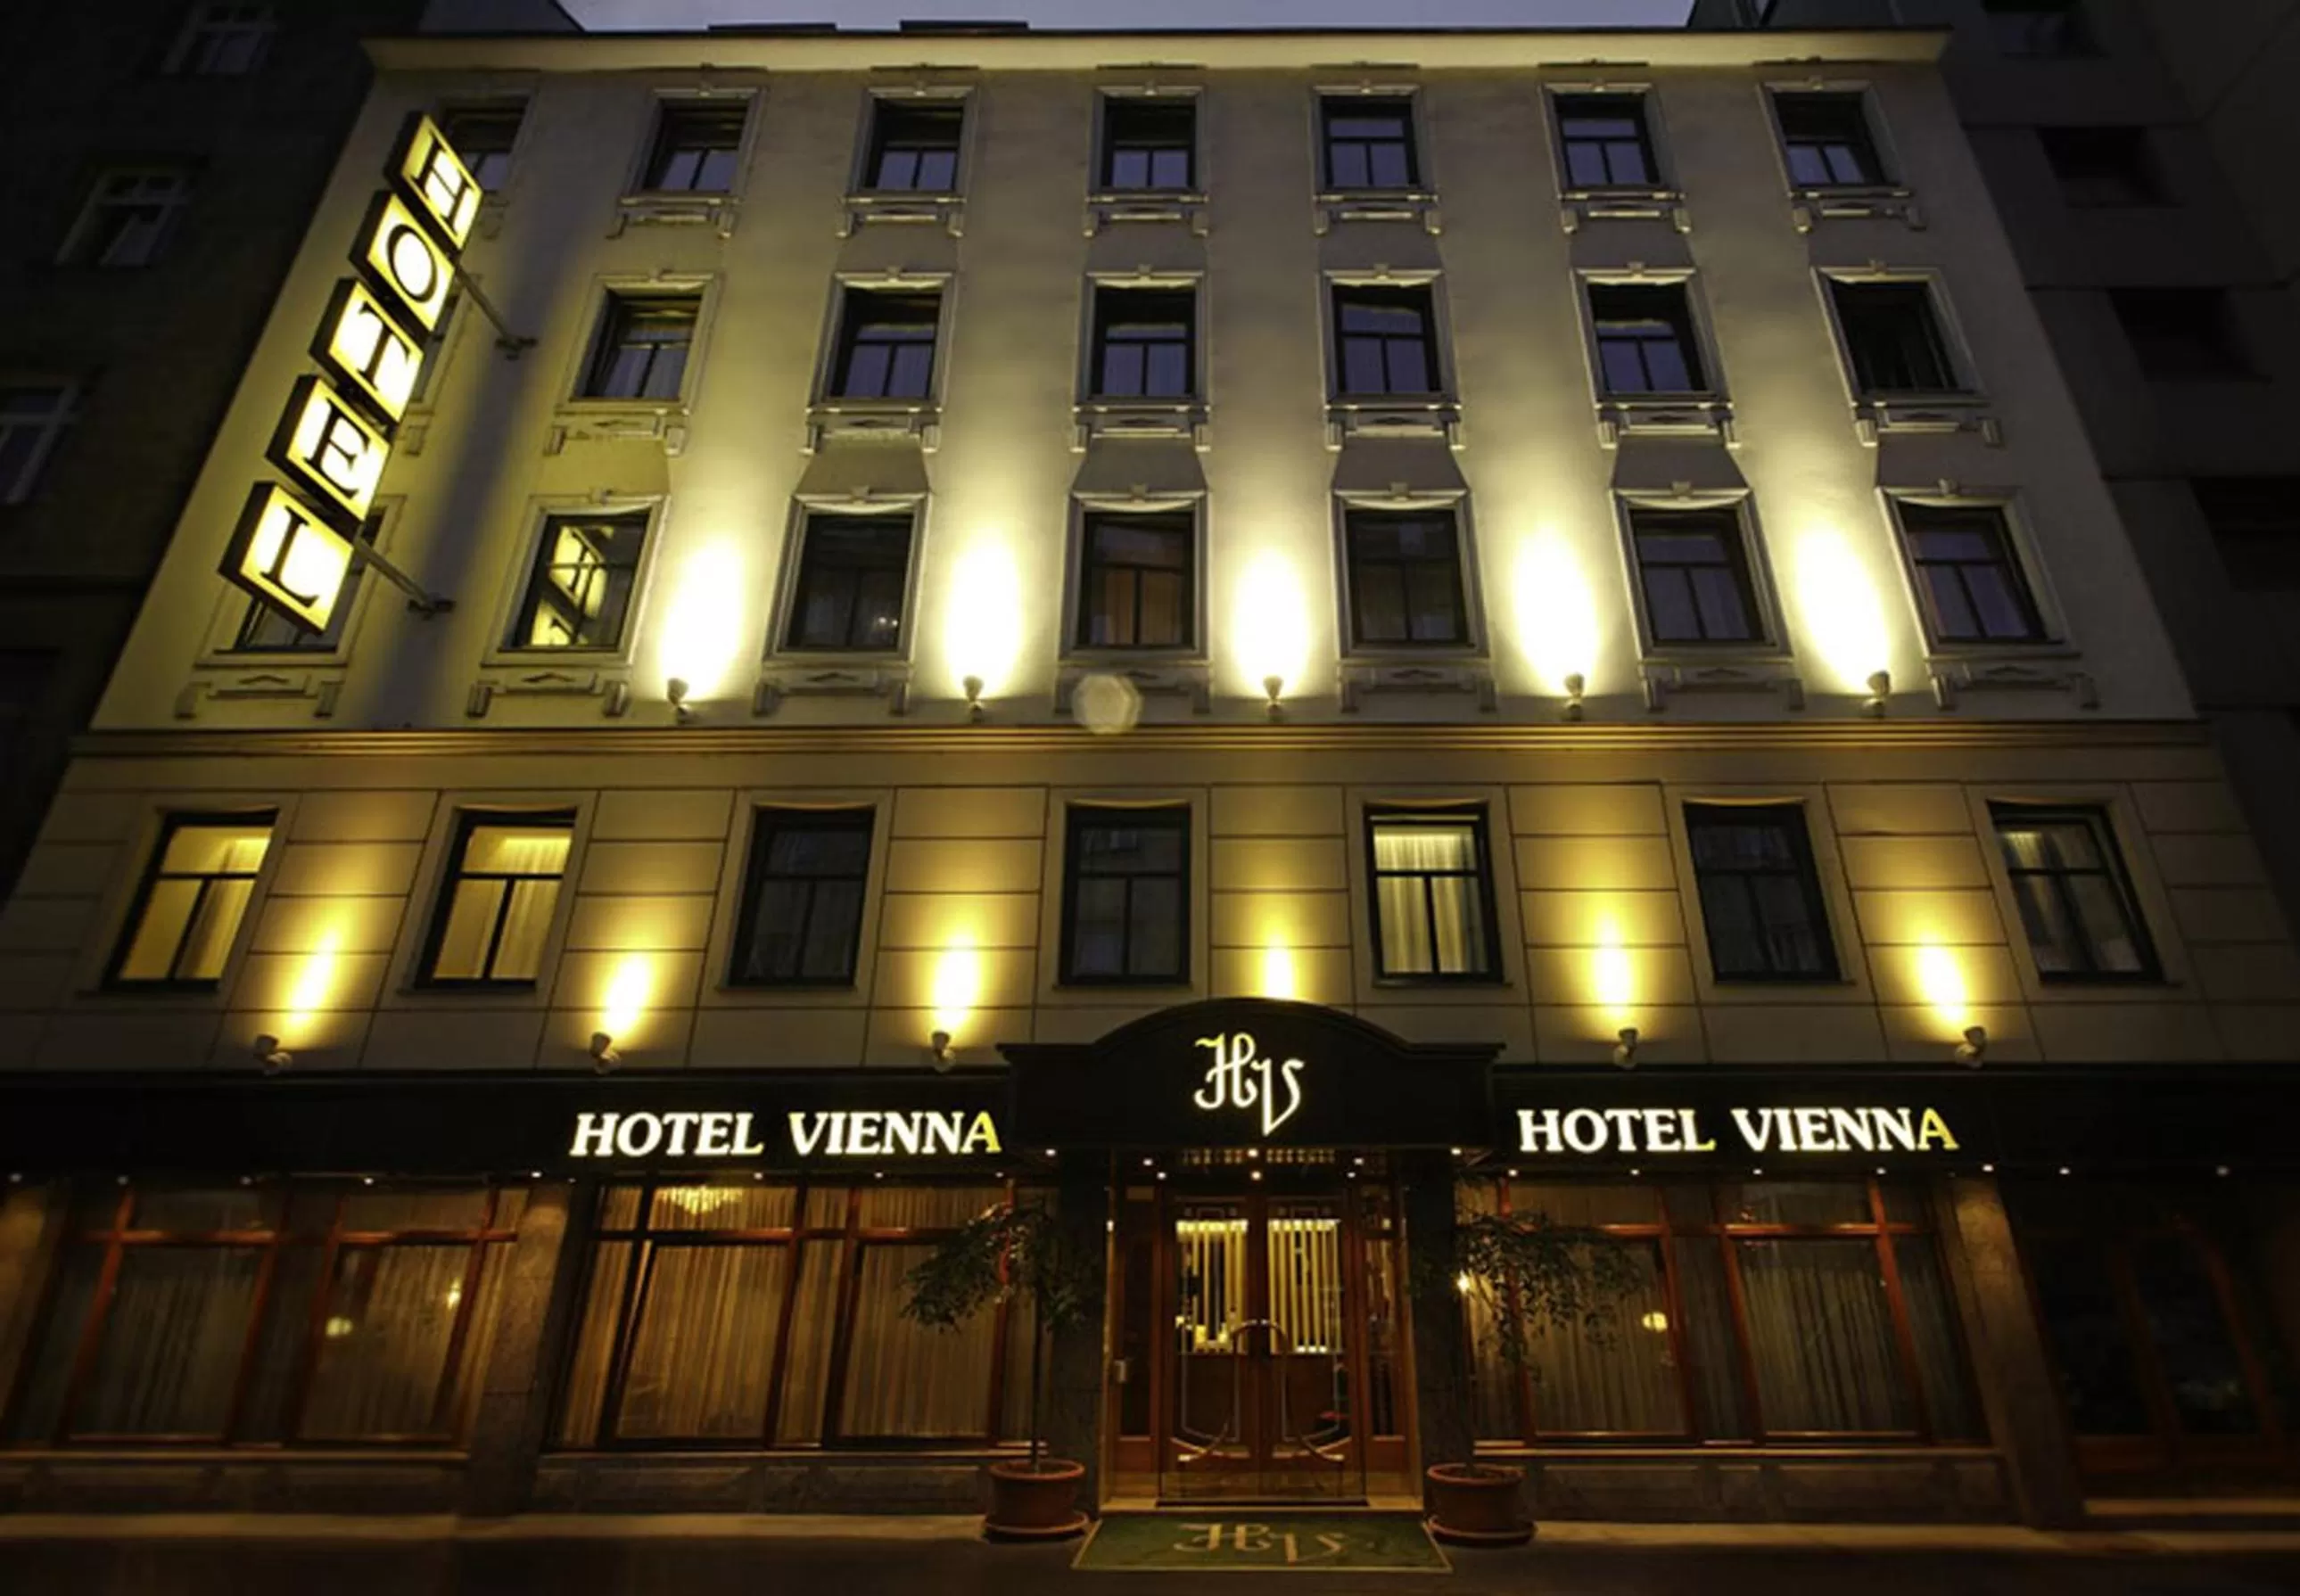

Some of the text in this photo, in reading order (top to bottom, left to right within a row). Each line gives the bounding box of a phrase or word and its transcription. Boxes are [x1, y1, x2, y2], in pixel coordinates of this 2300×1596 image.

[259, 129, 479, 608] HOTEL
[569, 1111, 1002, 1156] HOTEL VIENNA
[1516, 1107, 1959, 1153] HOTEL VIENNA
